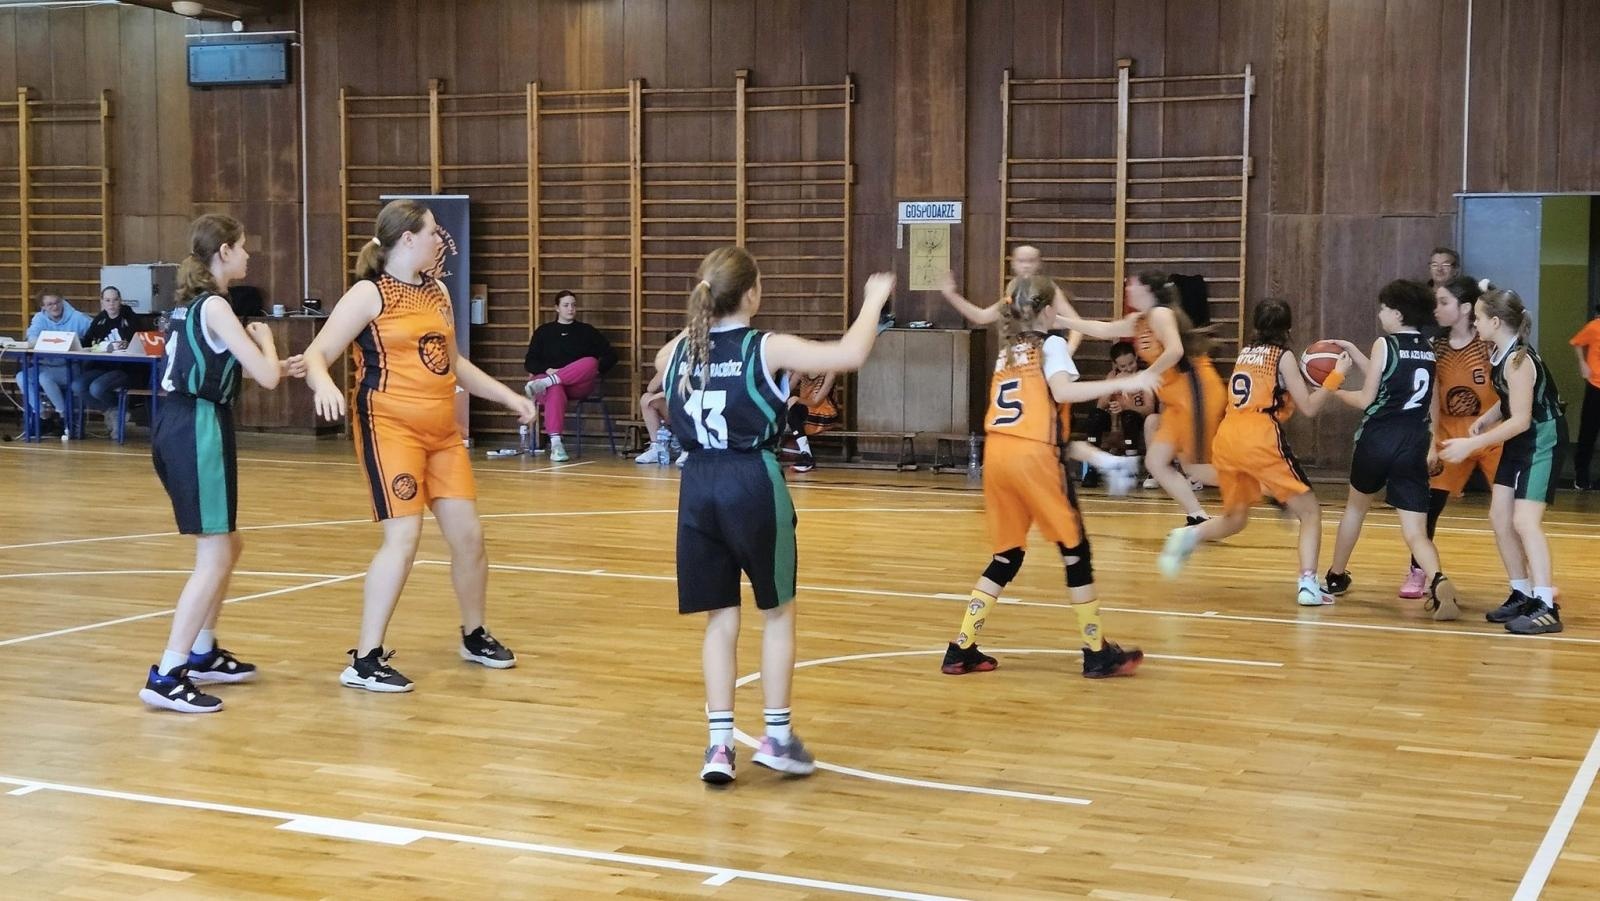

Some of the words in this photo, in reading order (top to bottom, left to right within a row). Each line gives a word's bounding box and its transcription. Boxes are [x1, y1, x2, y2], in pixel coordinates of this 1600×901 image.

[905, 203, 955, 219] GOSPODARZE
[1231, 372, 1252, 408] 9
[1402, 367, 1430, 411] 2
[1473, 368, 1485, 385] 6
[683, 389, 728, 449] 13
[993, 378, 1024, 427] 5
